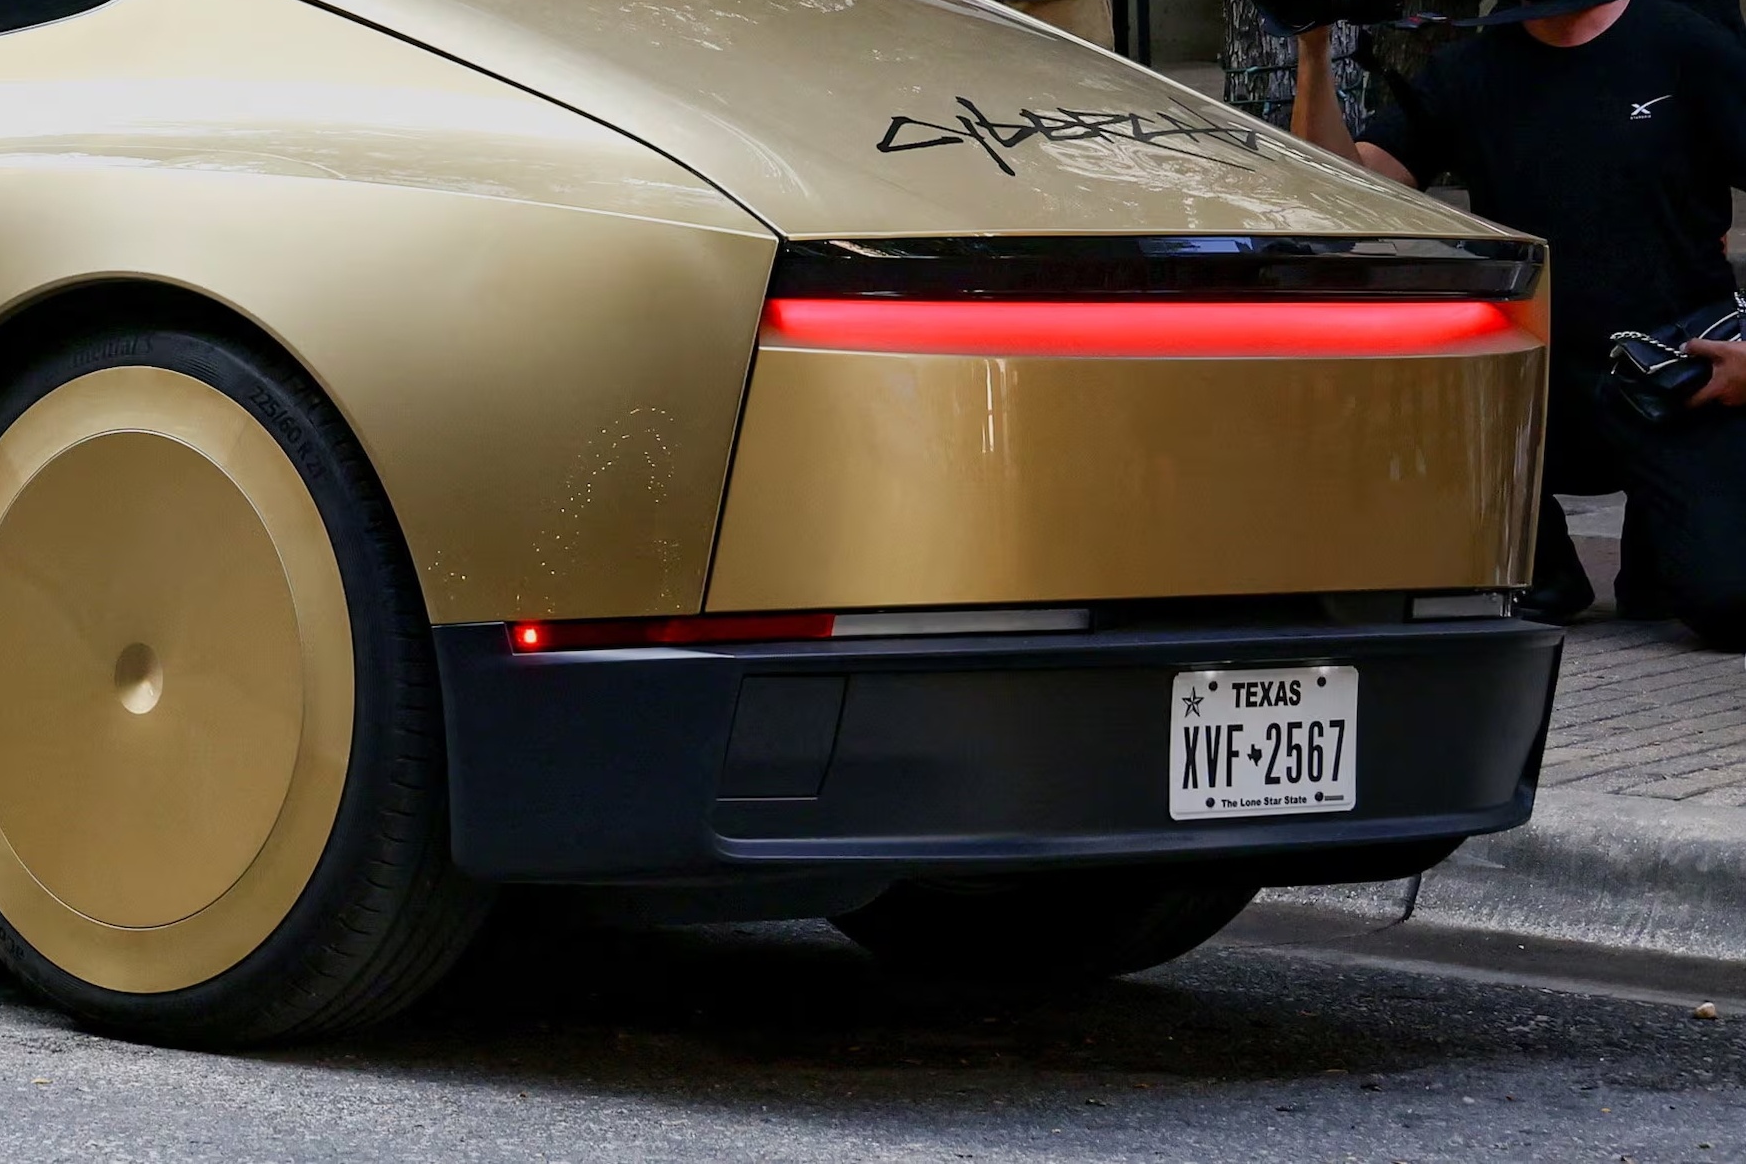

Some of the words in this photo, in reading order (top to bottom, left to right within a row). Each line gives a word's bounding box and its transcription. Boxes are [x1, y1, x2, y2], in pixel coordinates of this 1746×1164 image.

[1231, 679, 1302, 709] TEXAS
[1220, 797, 1238, 809] The
[1239, 797, 1263, 808] Lone
[1263, 796, 1282, 807] Star
[1284, 795, 1307, 806] State
